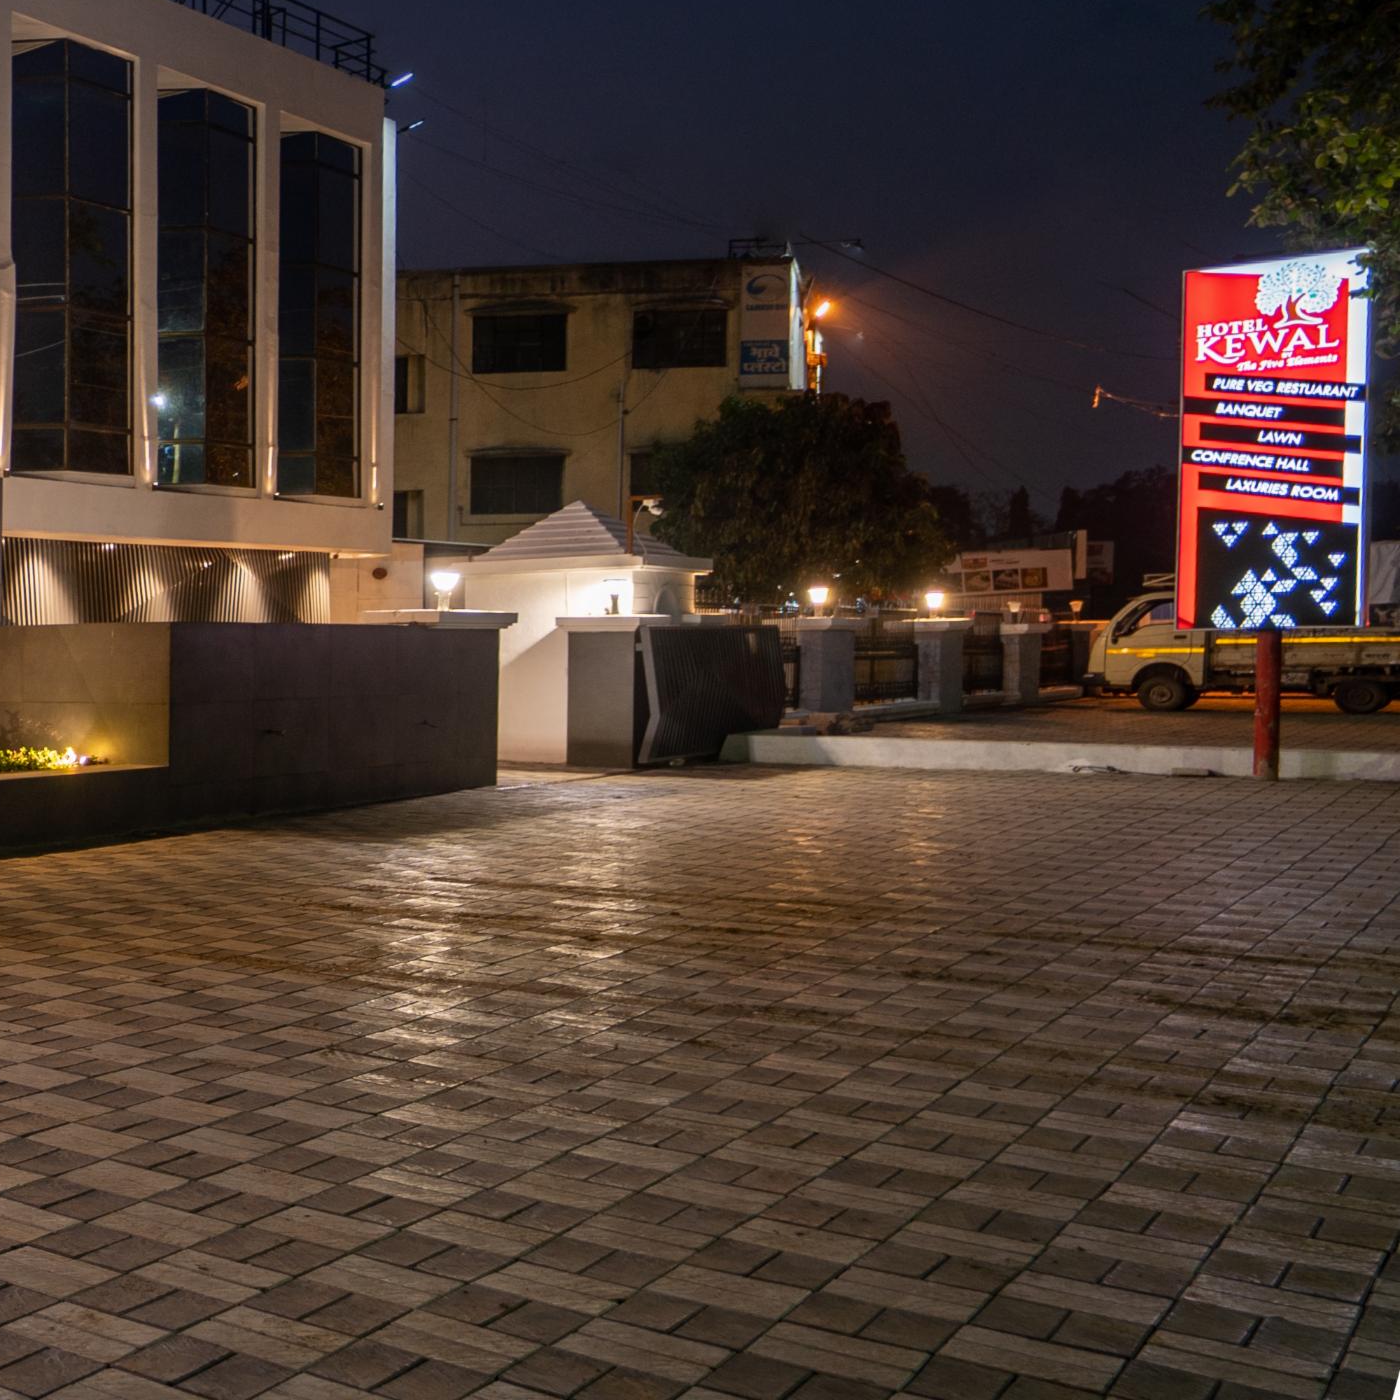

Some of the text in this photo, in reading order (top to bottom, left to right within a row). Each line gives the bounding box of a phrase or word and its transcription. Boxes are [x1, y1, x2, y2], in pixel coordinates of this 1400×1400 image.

[1196, 318, 1269, 338] HOTEL
[1195, 324, 1340, 365] KEWAL
[1213, 377, 1358, 398] PURE VEG RESTUARANT
[1215, 402, 1283, 419] BANQUET
[1257, 429, 1302, 445] LAWN
[1190, 449, 1310, 472] CONFRENCE HALL
[1225, 477, 1339, 501] LAXURIES ROOM
